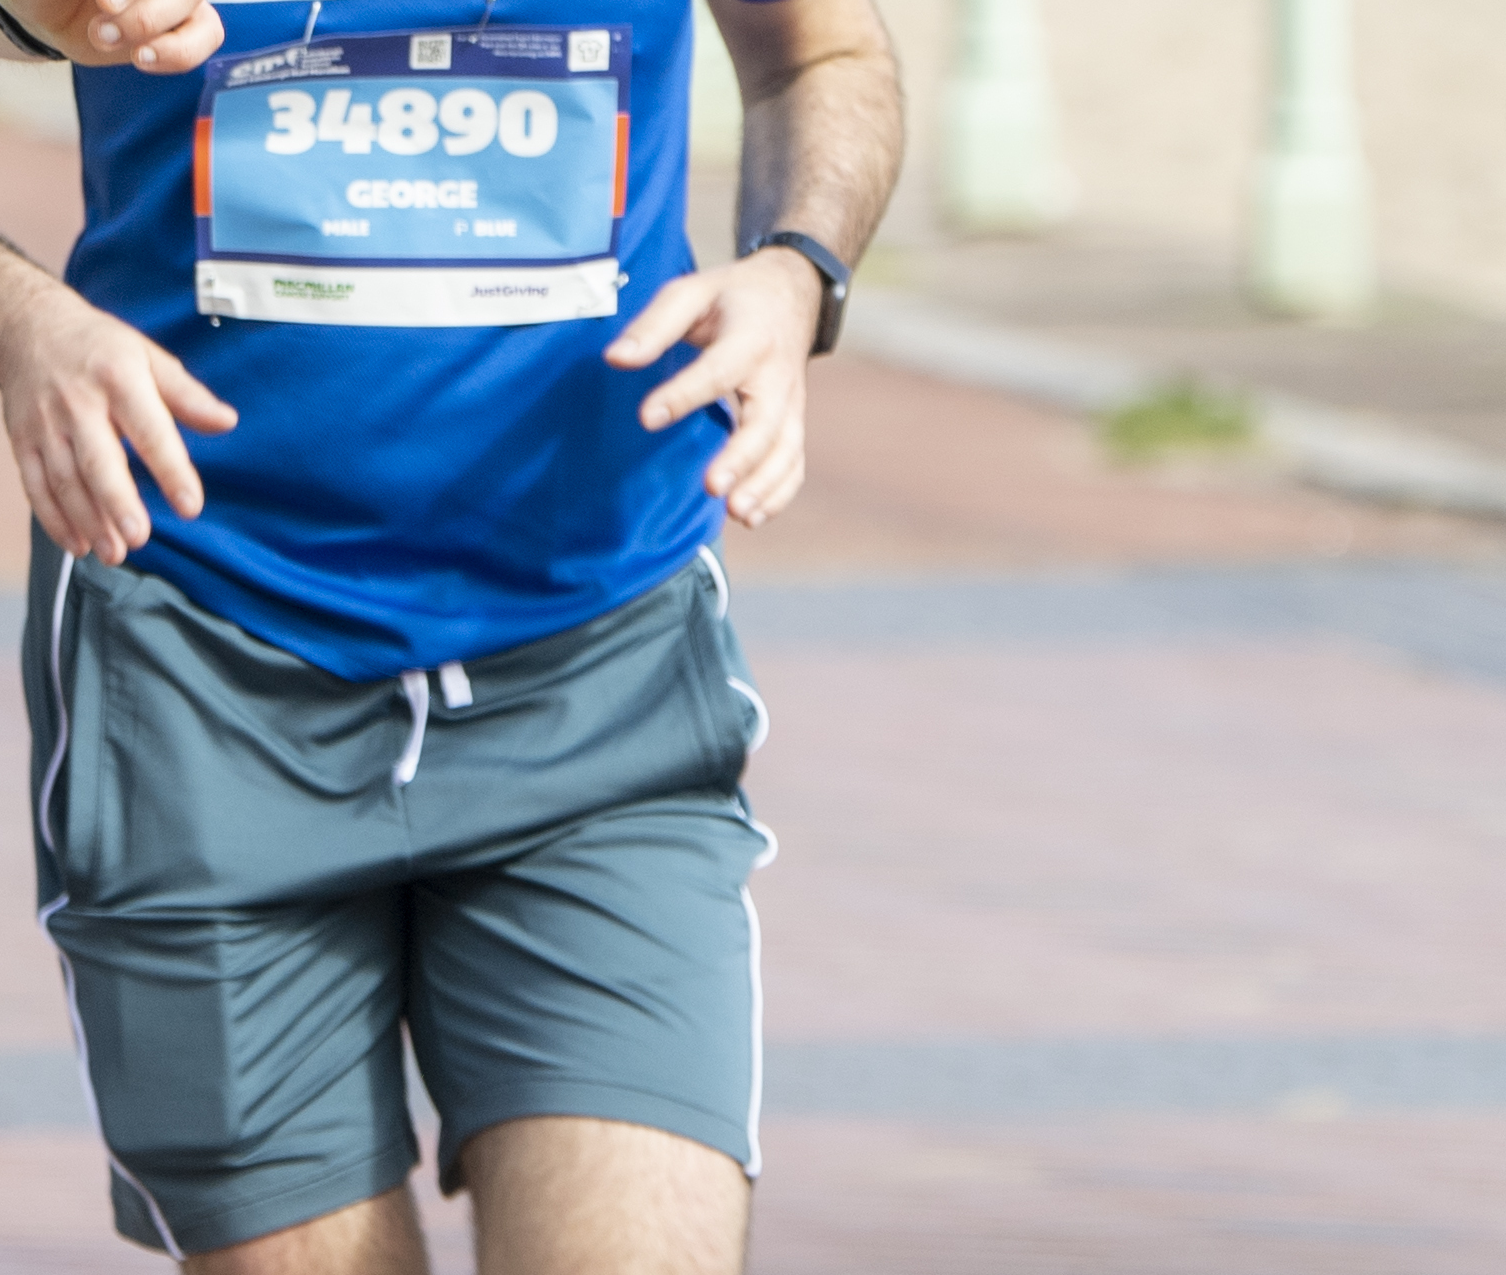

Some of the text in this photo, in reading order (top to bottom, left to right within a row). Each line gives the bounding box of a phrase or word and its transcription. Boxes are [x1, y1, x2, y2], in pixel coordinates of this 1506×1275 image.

[264, 88, 559, 158] 34890
[346, 179, 479, 209] GEORGE
[322, 219, 518, 237] MALE BLUE
[470, 284, 549, 299] JustGiving
